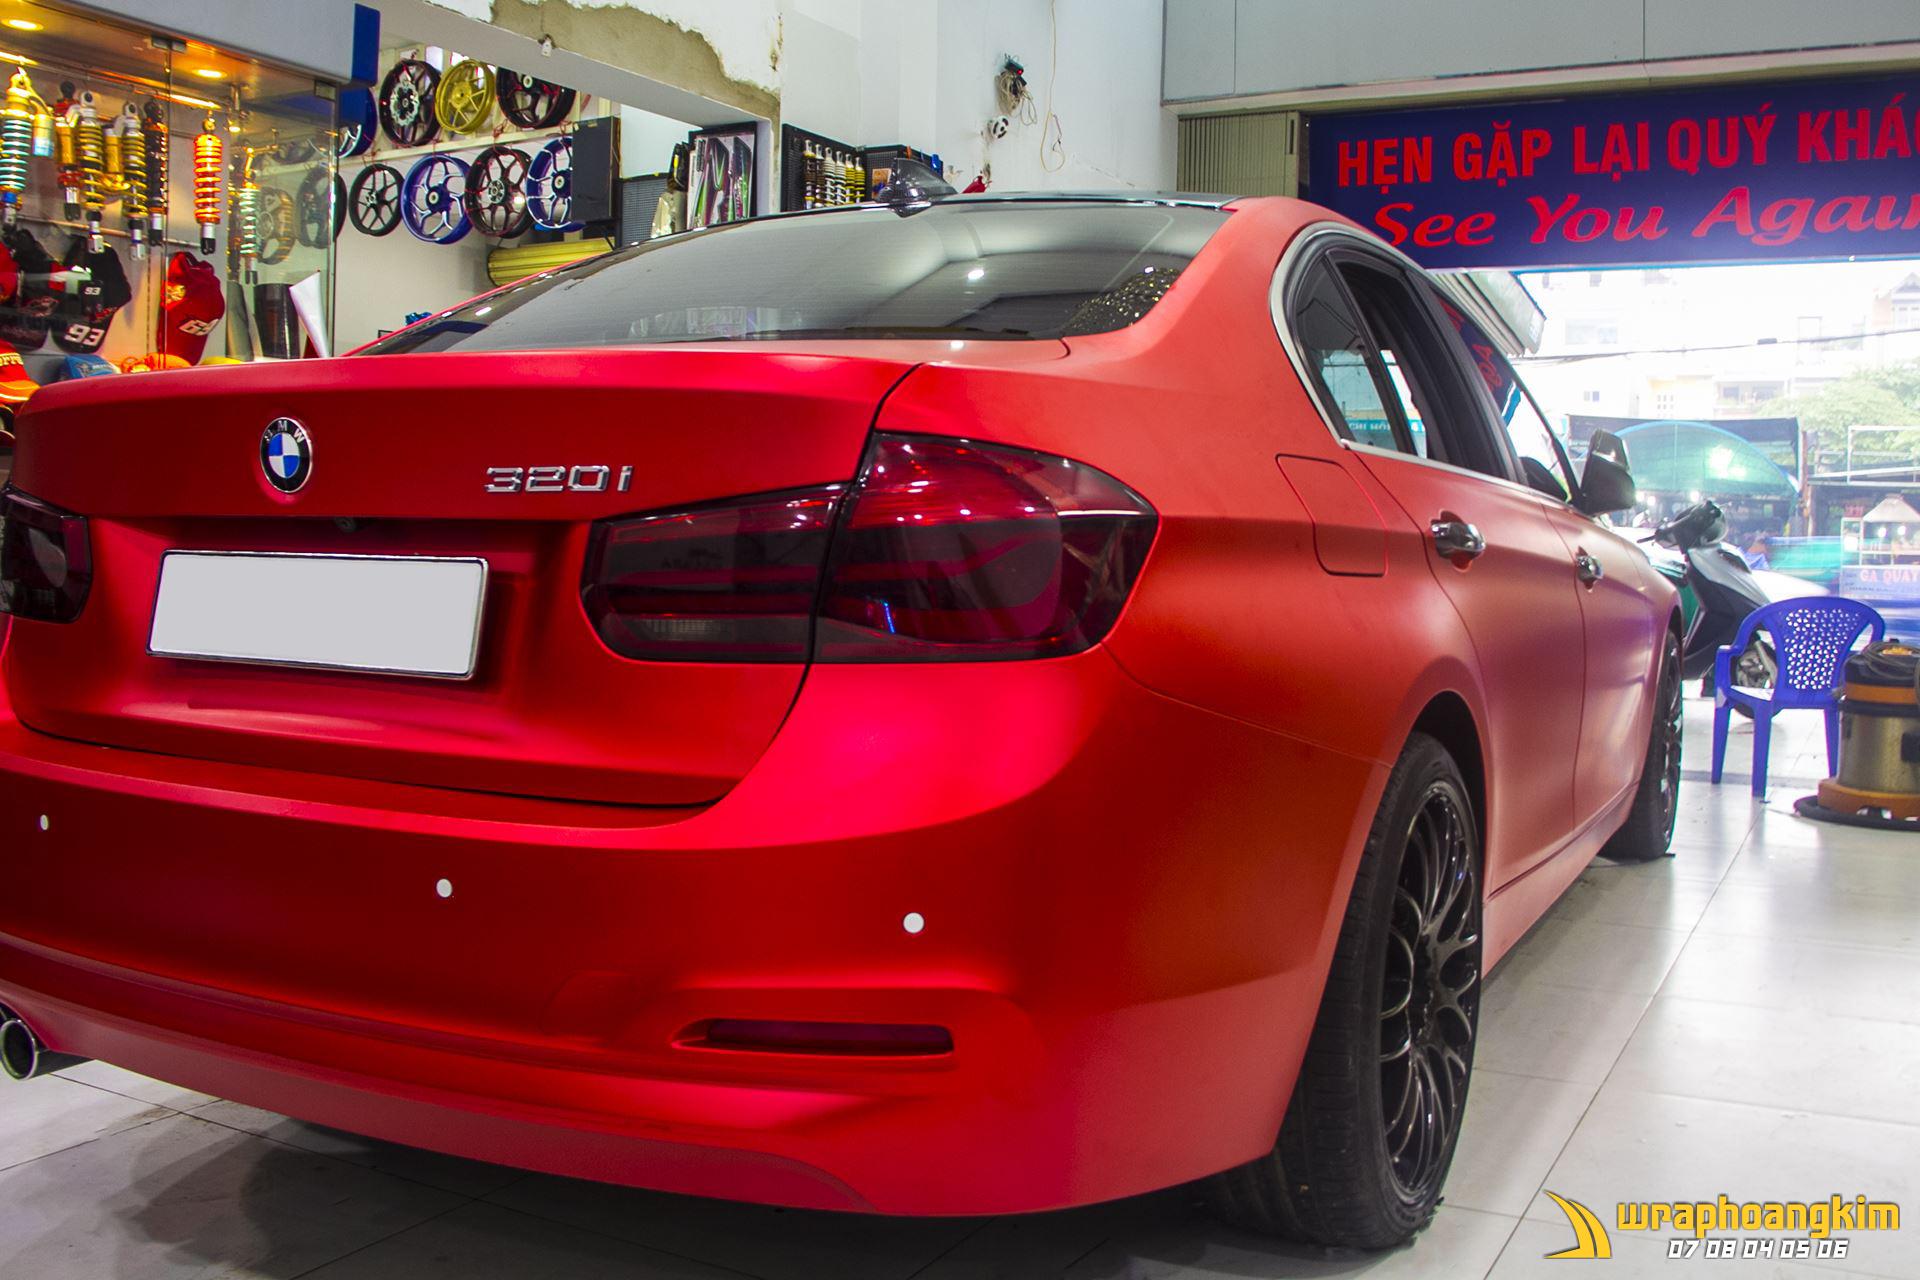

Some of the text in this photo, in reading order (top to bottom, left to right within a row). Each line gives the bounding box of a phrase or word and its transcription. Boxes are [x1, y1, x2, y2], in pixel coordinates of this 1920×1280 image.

[1338, 92, 1920, 194] HẸN GẶP LẠI QUÝ KHÁ
[1374, 202, 1497, 248] See
[1526, 193, 1668, 244] You
[64, 323, 105, 347] 93
[484, 465, 633, 493] 320i
